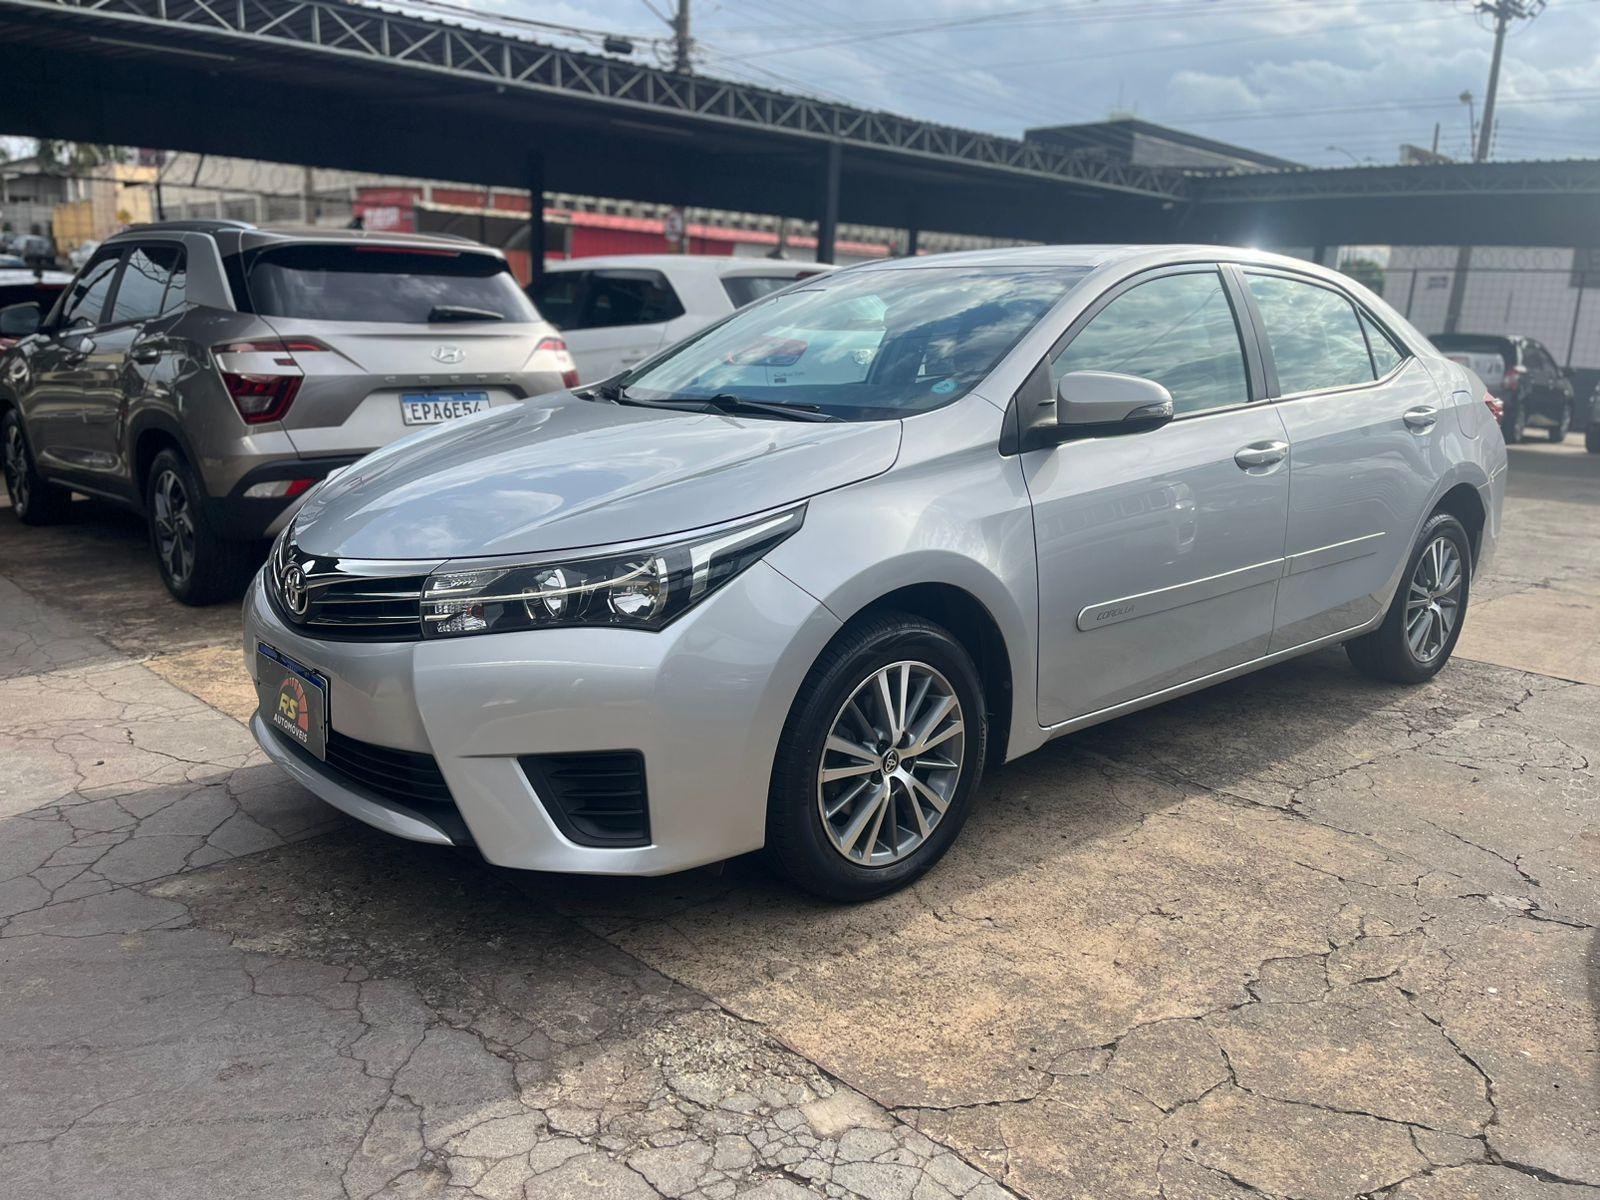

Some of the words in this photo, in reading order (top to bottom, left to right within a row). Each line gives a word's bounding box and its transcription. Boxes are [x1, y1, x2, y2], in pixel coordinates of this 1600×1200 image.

[411, 401, 482, 421] EPA6E54
[279, 692, 299, 720] RS
[273, 713, 308, 744] AUTOMÓVEIS
